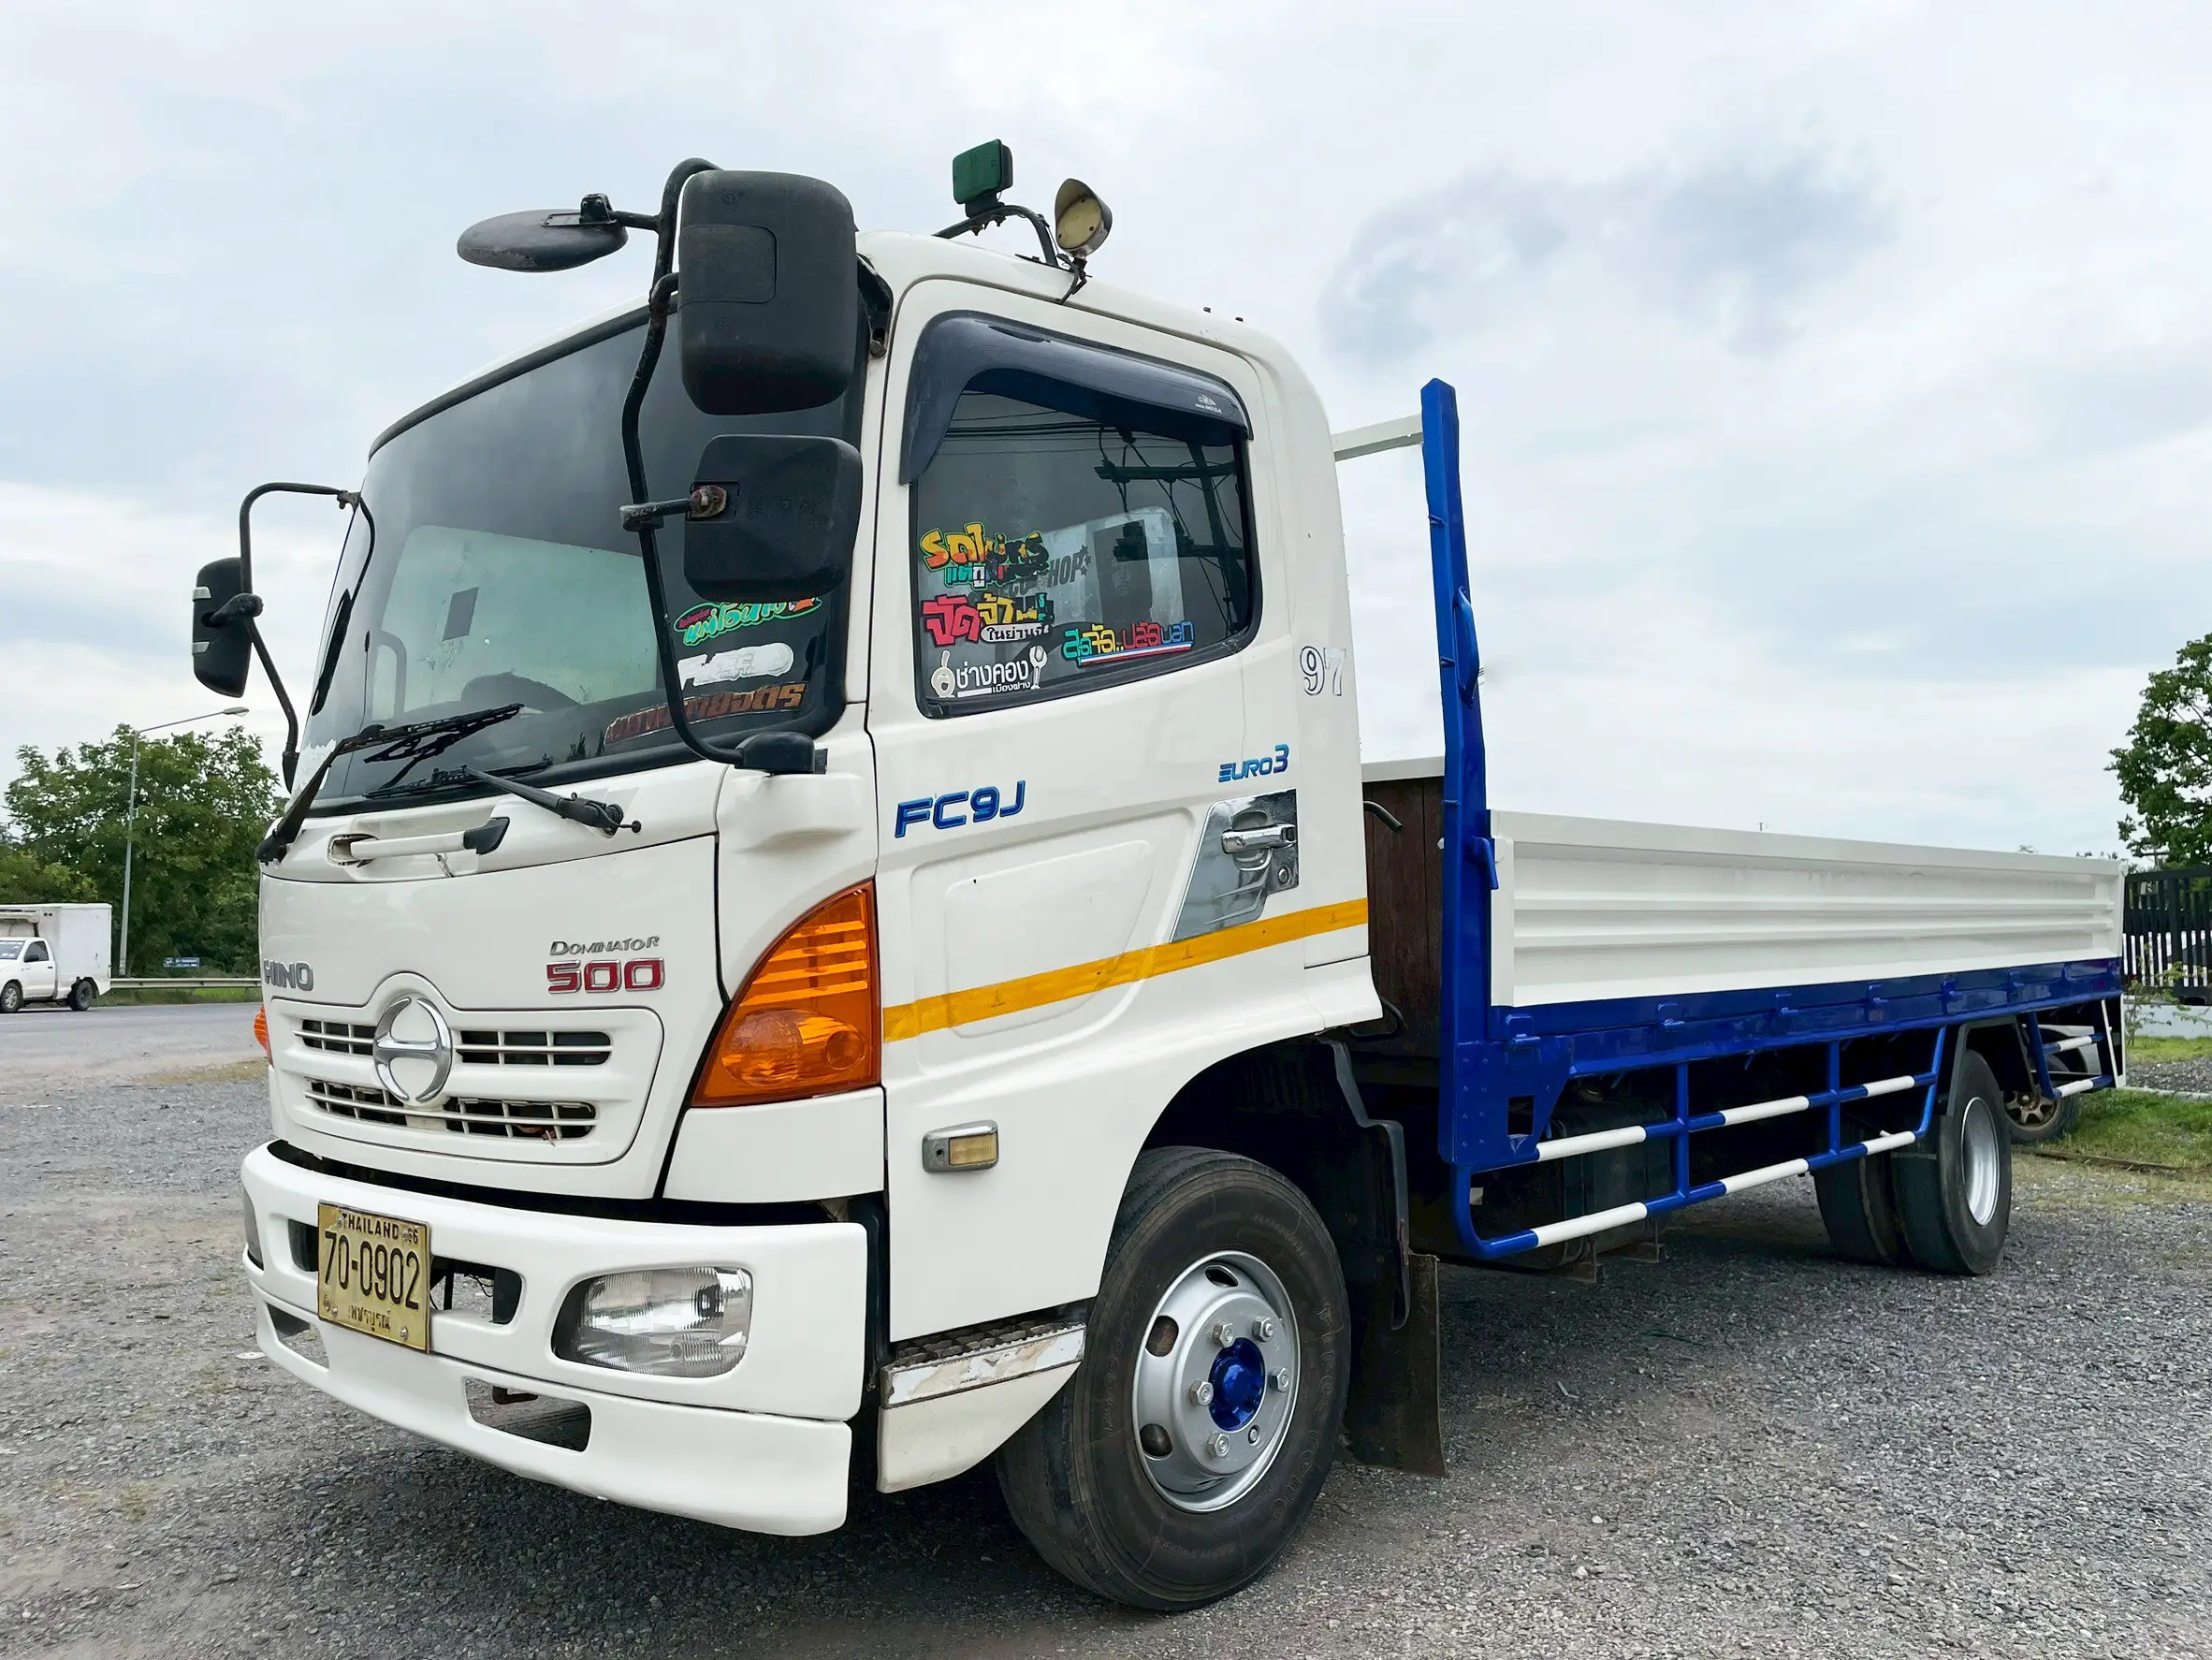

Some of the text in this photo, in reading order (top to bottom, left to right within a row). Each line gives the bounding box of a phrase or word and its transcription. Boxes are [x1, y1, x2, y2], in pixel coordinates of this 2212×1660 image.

[956, 660, 1028, 690] ช่างคอง
[1300, 646, 1346, 696] 97
[895, 779, 1026, 838] FC9J
[263, 959, 314, 992] HINO
[546, 956, 665, 994] 500
[342, 1213, 400, 1240] THAILAND
[324, 1230, 420, 1310] 70-0902
